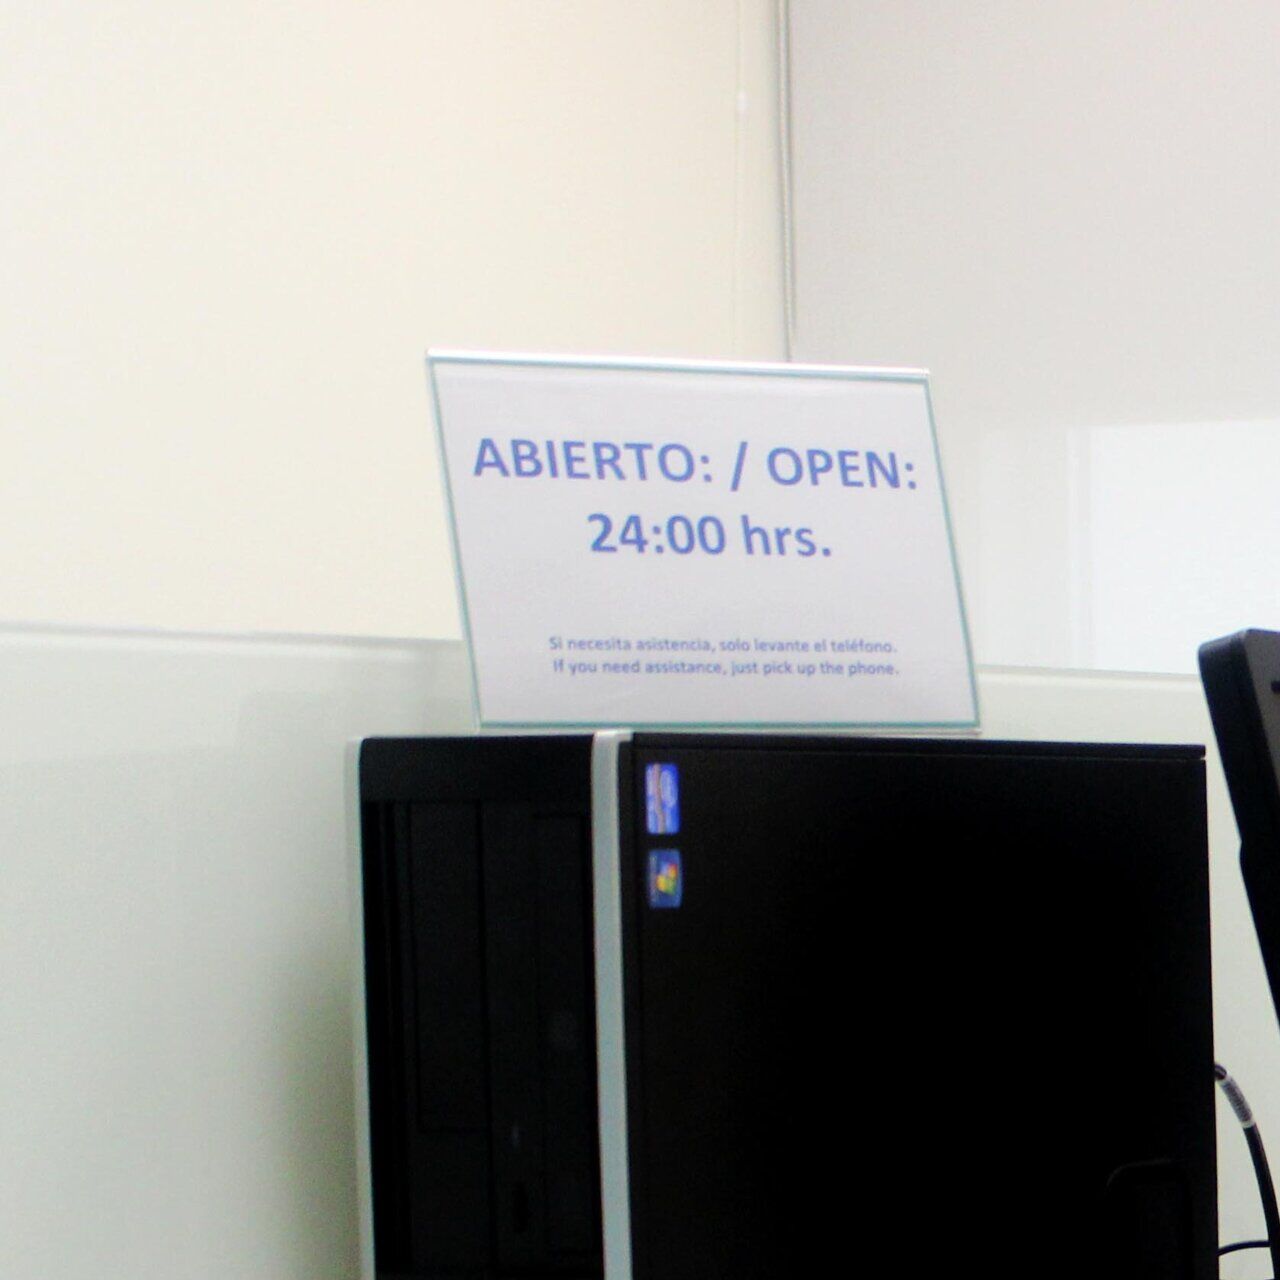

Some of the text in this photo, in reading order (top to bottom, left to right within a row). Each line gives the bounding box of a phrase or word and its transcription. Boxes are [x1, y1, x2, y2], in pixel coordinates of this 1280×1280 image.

[473, 437, 918, 491] ABIERTO: / OPEN:
[586, 513, 832, 557] 24:00 hrs.
[548, 636, 898, 653] Si necesita asistencia, solo levante el teléfono.
[553, 658, 901, 677] If you need assistance, just pick up the phone.
